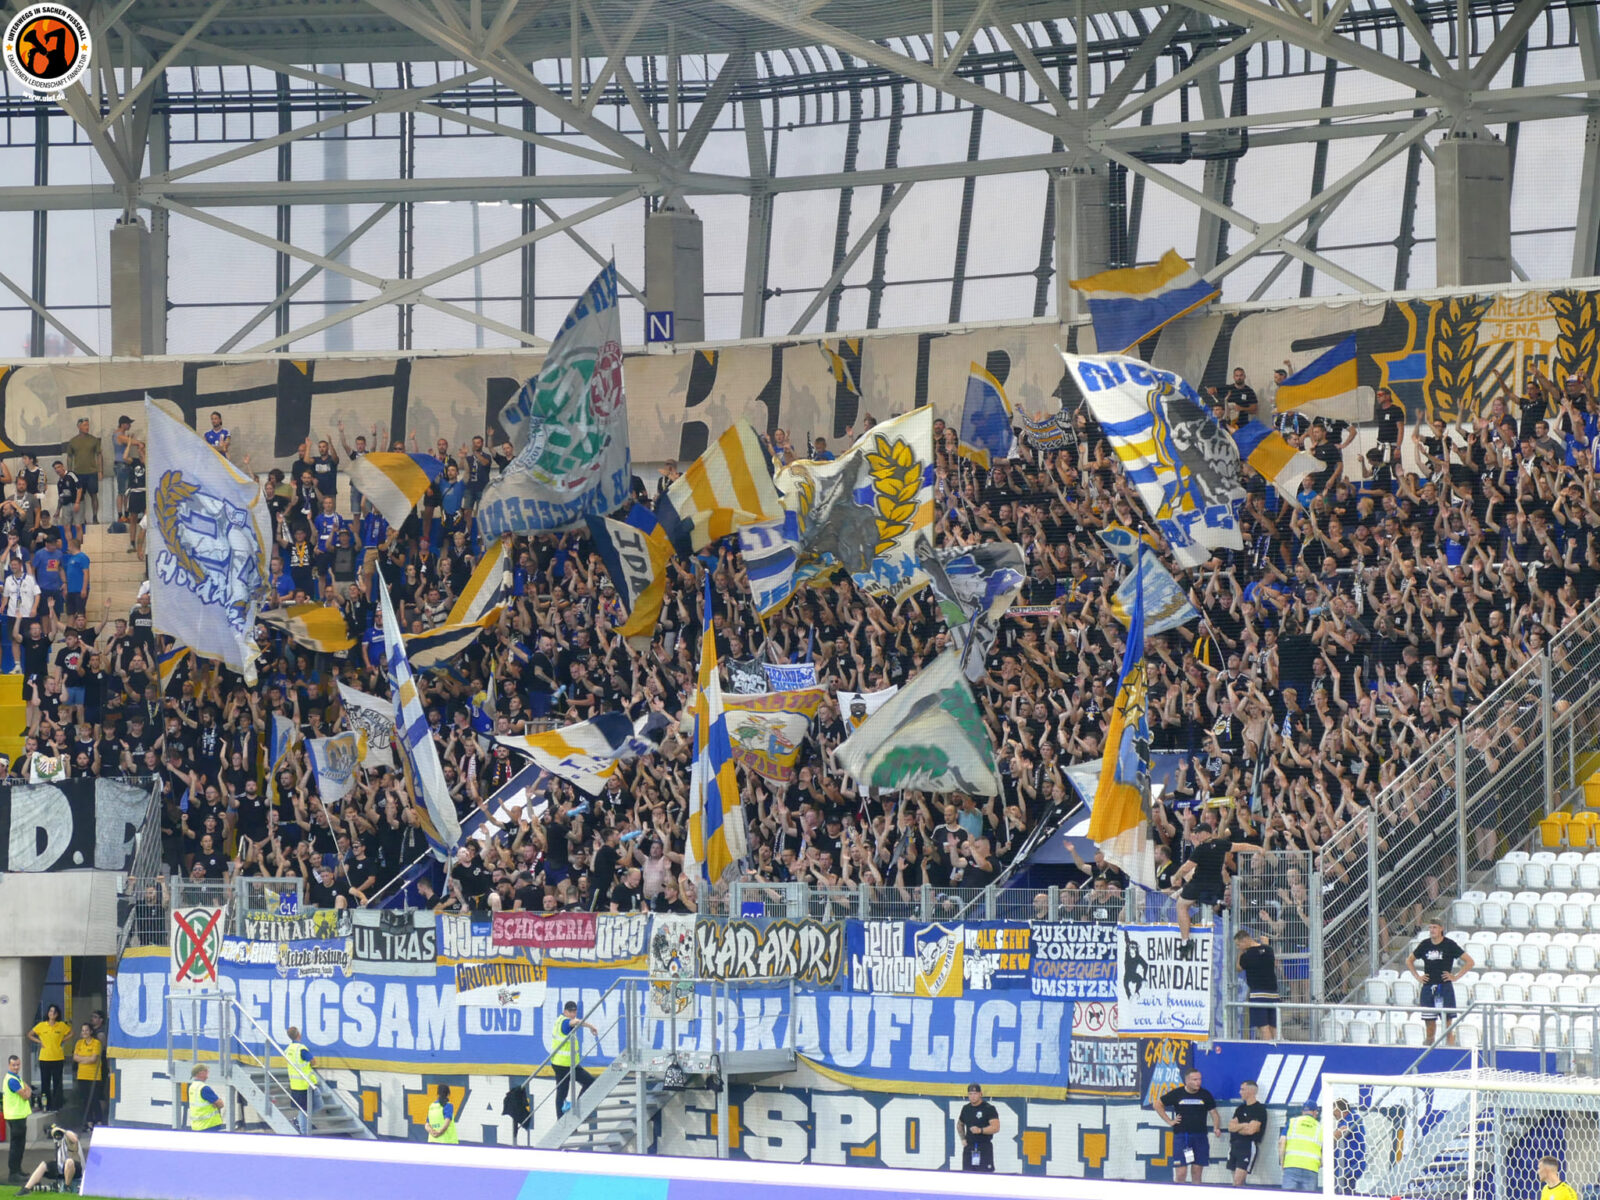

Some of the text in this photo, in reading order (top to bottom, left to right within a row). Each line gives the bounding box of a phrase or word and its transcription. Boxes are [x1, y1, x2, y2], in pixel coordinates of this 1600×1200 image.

[650, 313, 671, 340] N
[1491, 322, 1540, 339] JENA
[280, 902, 297, 915] C14
[245, 918, 317, 941] WEIMAR
[493, 918, 596, 941] SCHICKERIA
[354, 927, 436, 961] ULTRAS
[1148, 964, 1209, 991] RANDALE
[480, 1006, 522, 1033] UND
[1170, 1011, 1206, 1030] Saale
[1069, 1039, 1139, 1064] REFUGEES
[1068, 1064, 1139, 1087] WELCOME
